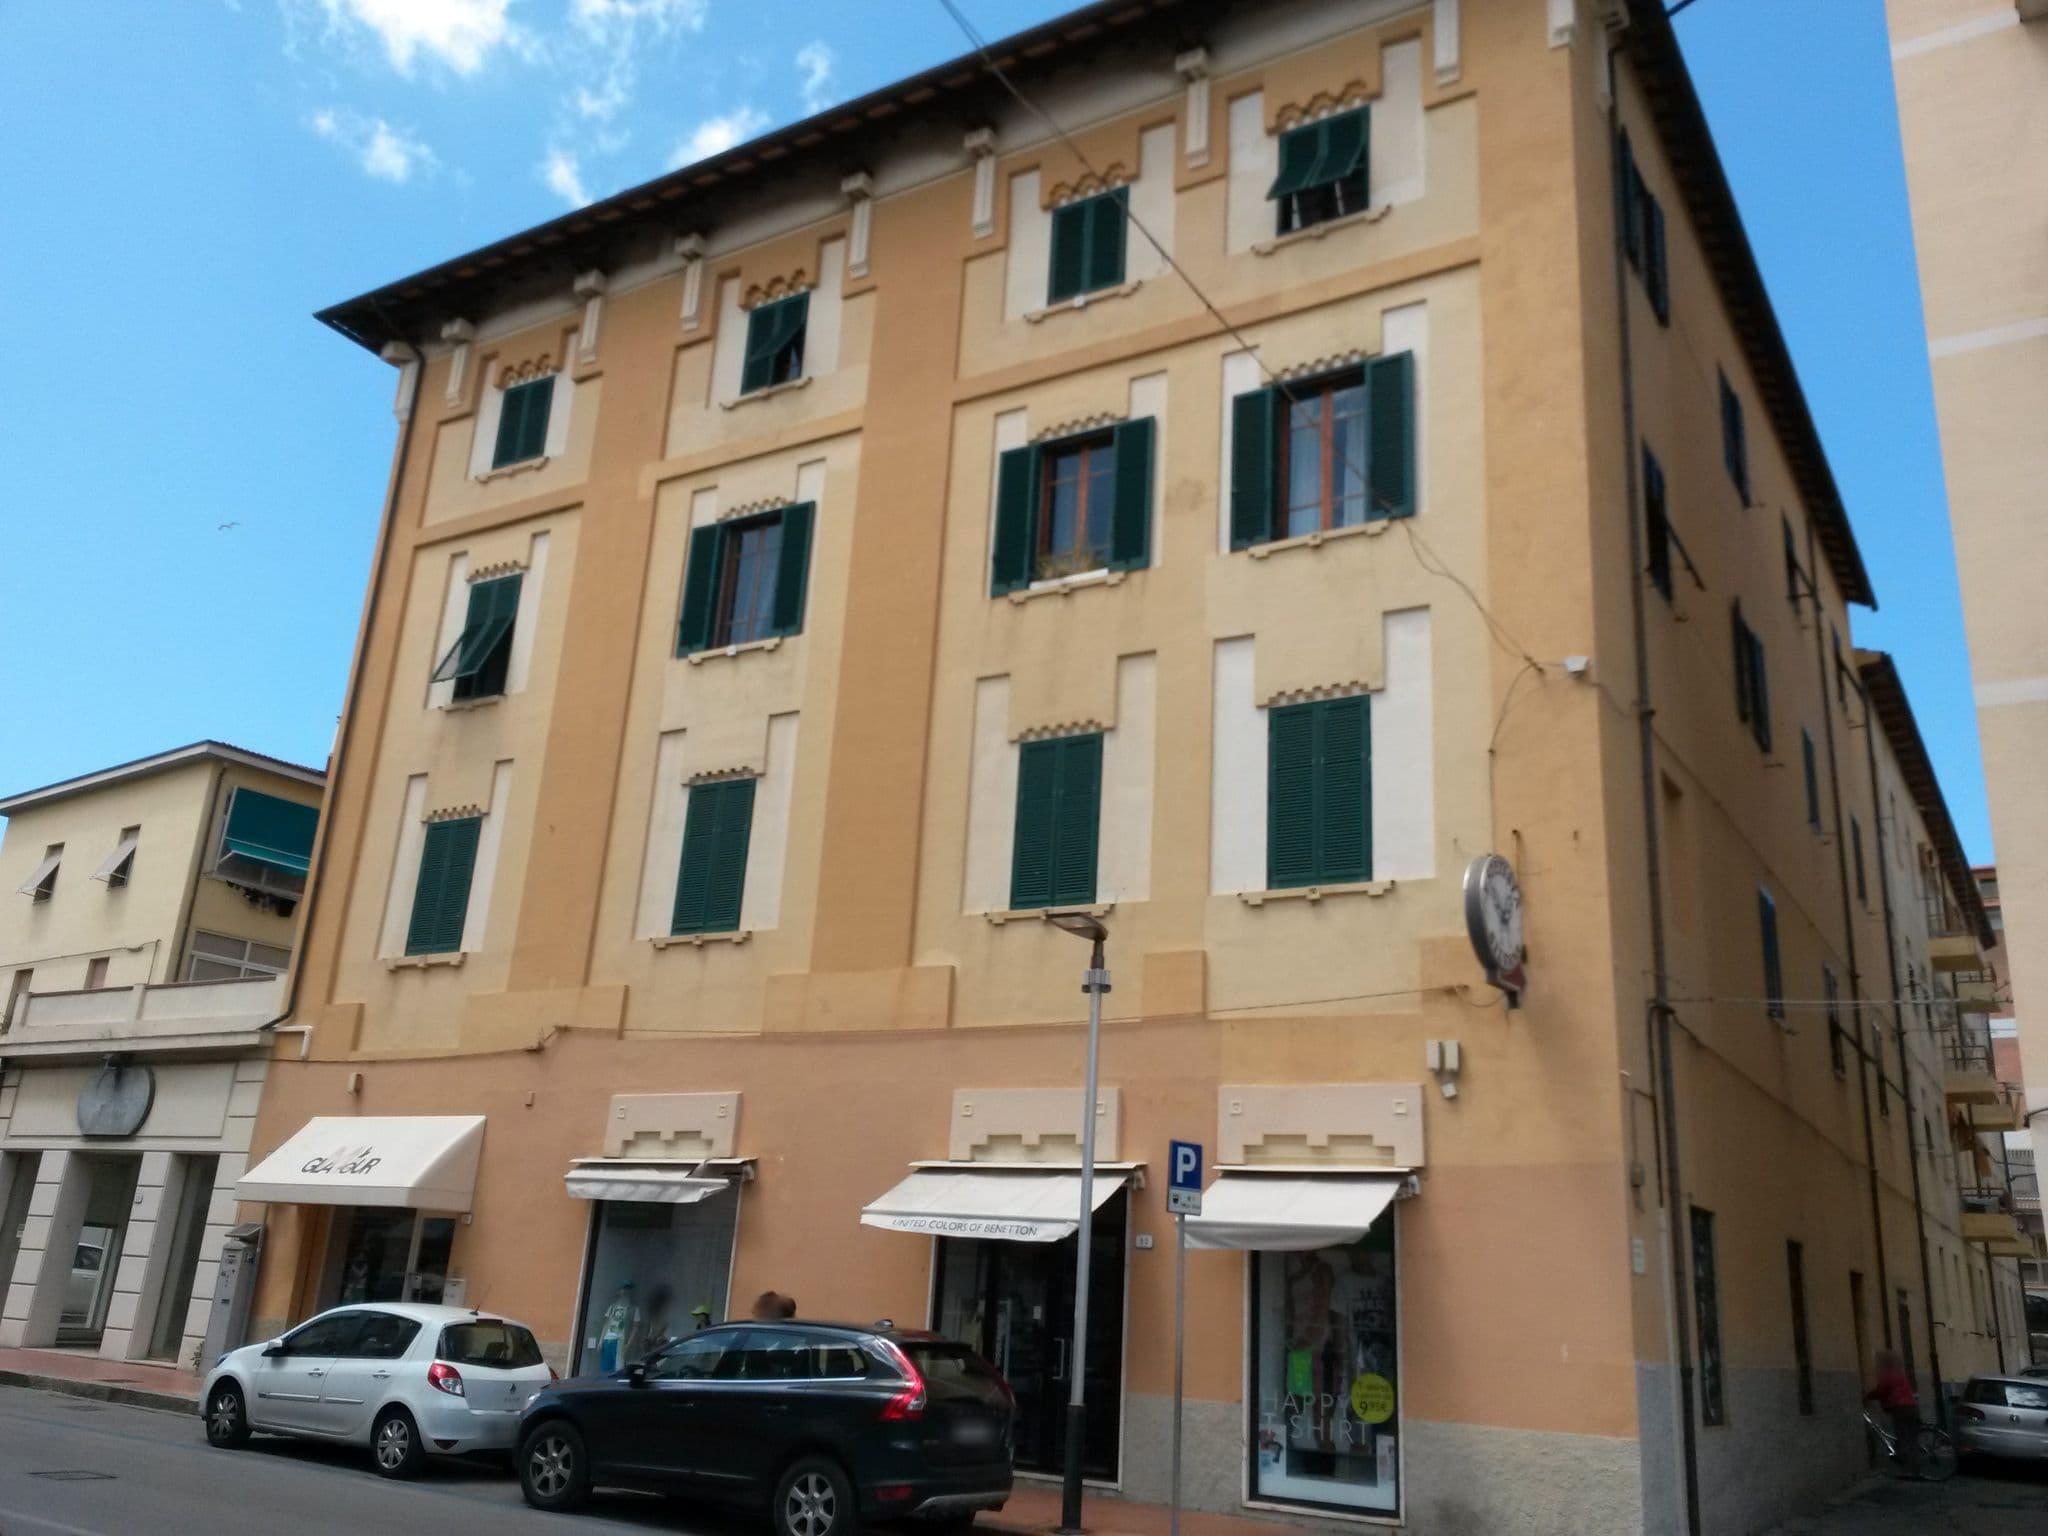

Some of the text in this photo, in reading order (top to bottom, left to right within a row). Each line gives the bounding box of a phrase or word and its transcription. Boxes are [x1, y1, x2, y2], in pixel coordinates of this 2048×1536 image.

[301, 1155, 382, 1175] GLAOUR
[1176, 1146, 1197, 1184] P
[892, 1219, 1038, 1236] UNITED COLORS OF BENETTON
